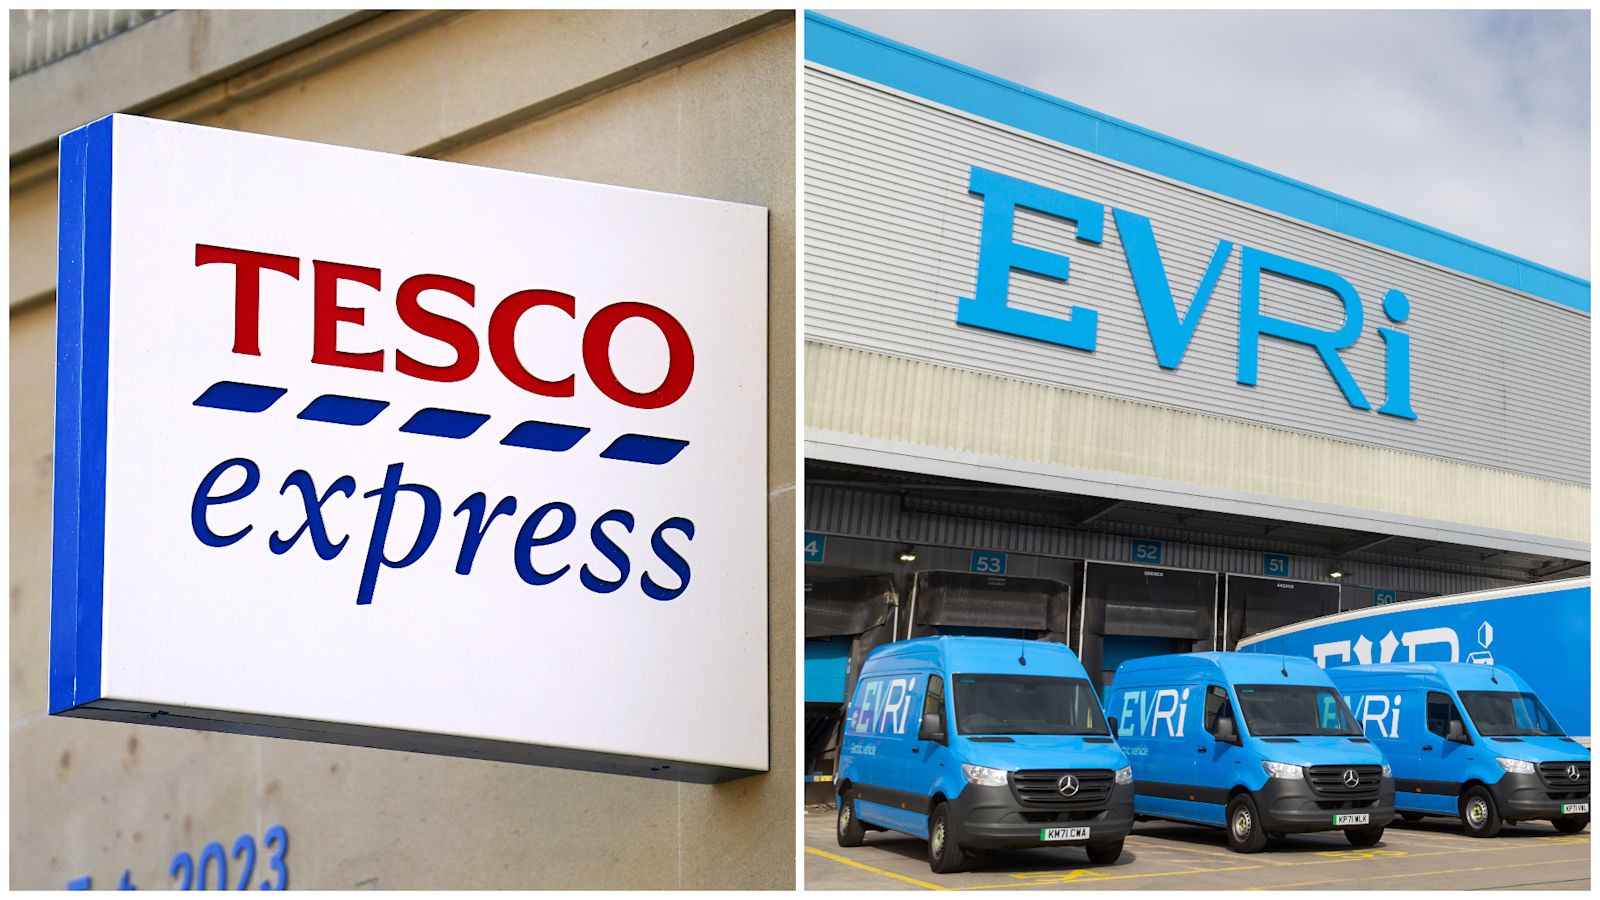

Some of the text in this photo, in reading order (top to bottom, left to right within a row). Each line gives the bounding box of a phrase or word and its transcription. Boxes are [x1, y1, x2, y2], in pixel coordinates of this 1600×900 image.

[956, 166, 1417, 420] EVRi
[195, 243, 695, 410] TESCO
[190, 457, 696, 605] express
[804, 540, 819, 557] 4
[1136, 544, 1158, 560] 52
[976, 556, 1001, 573] 53
[1269, 558, 1284, 573] 51
[1376, 593, 1393, 606] 50
[856, 677, 915, 734] EVRi
[1118, 687, 1190, 737] EVRi
[168, 824, 289, 891] 2023
